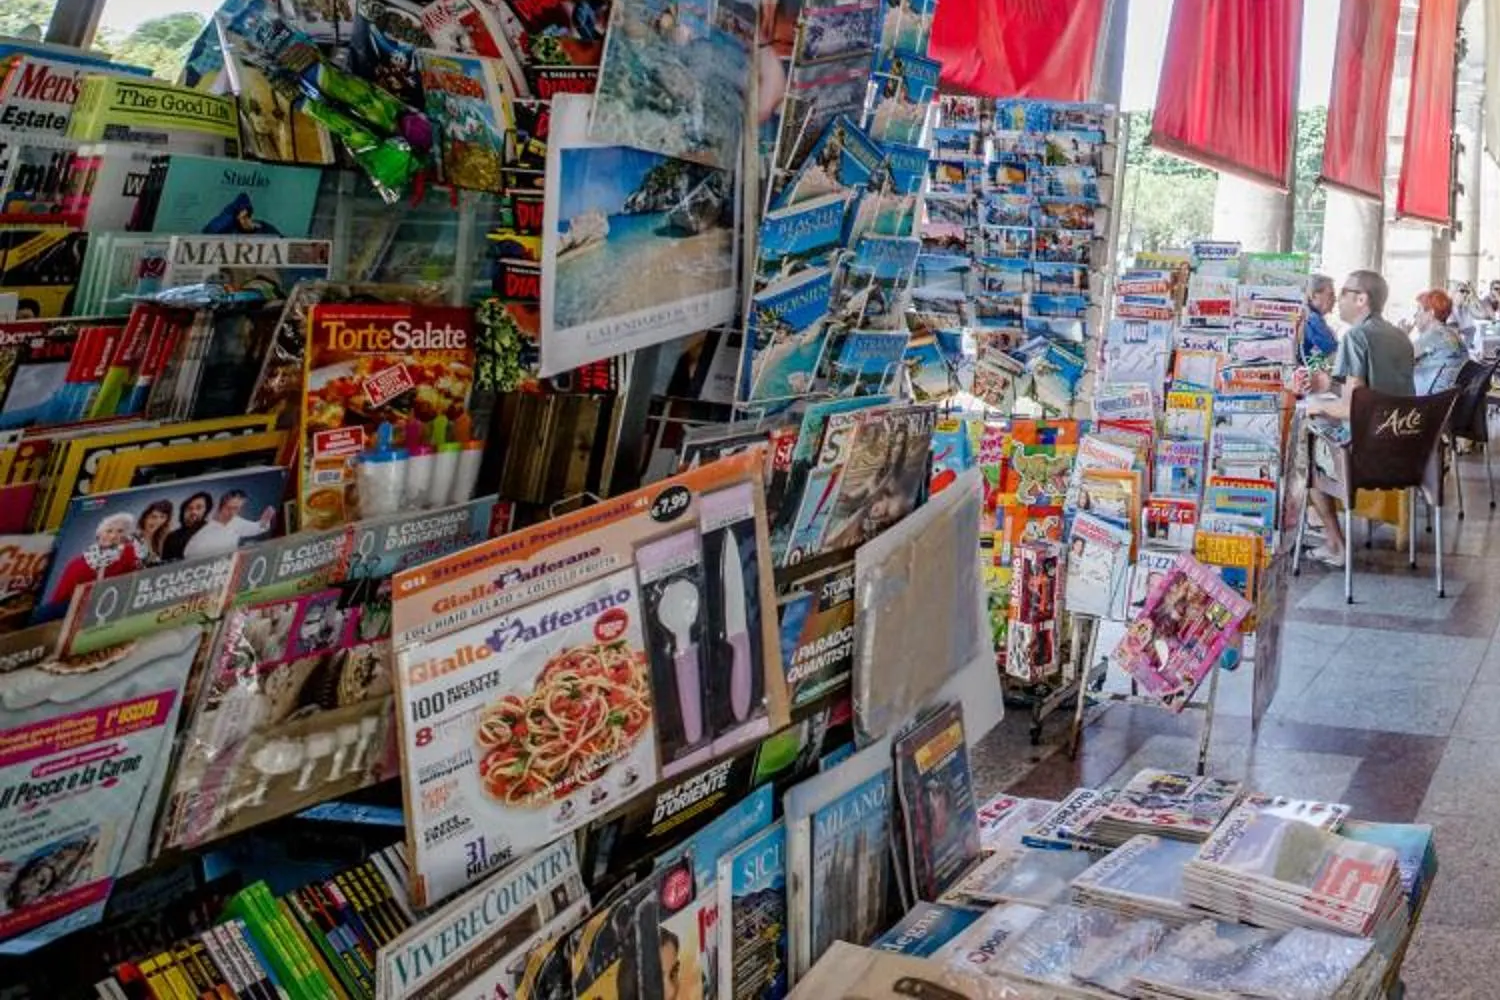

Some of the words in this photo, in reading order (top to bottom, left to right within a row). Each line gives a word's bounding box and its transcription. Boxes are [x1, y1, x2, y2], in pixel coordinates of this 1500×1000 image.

[12, 63, 82, 105] Men's
[116, 88, 158, 110] The
[160, 92, 202, 116] Good
[0, 106, 67, 133] Estate
[221, 167, 271, 190] Studio
[182, 240, 284, 266] MARIA
[1376, 408, 1423, 437] Arte
[431, 540, 527, 583] Strumenti
[411, 690, 446, 724] 100
[414, 724, 435, 748] 8
[15, 775, 66, 804] Pesce
[463, 835, 487, 865] 31
[465, 844, 514, 880] MELONE
